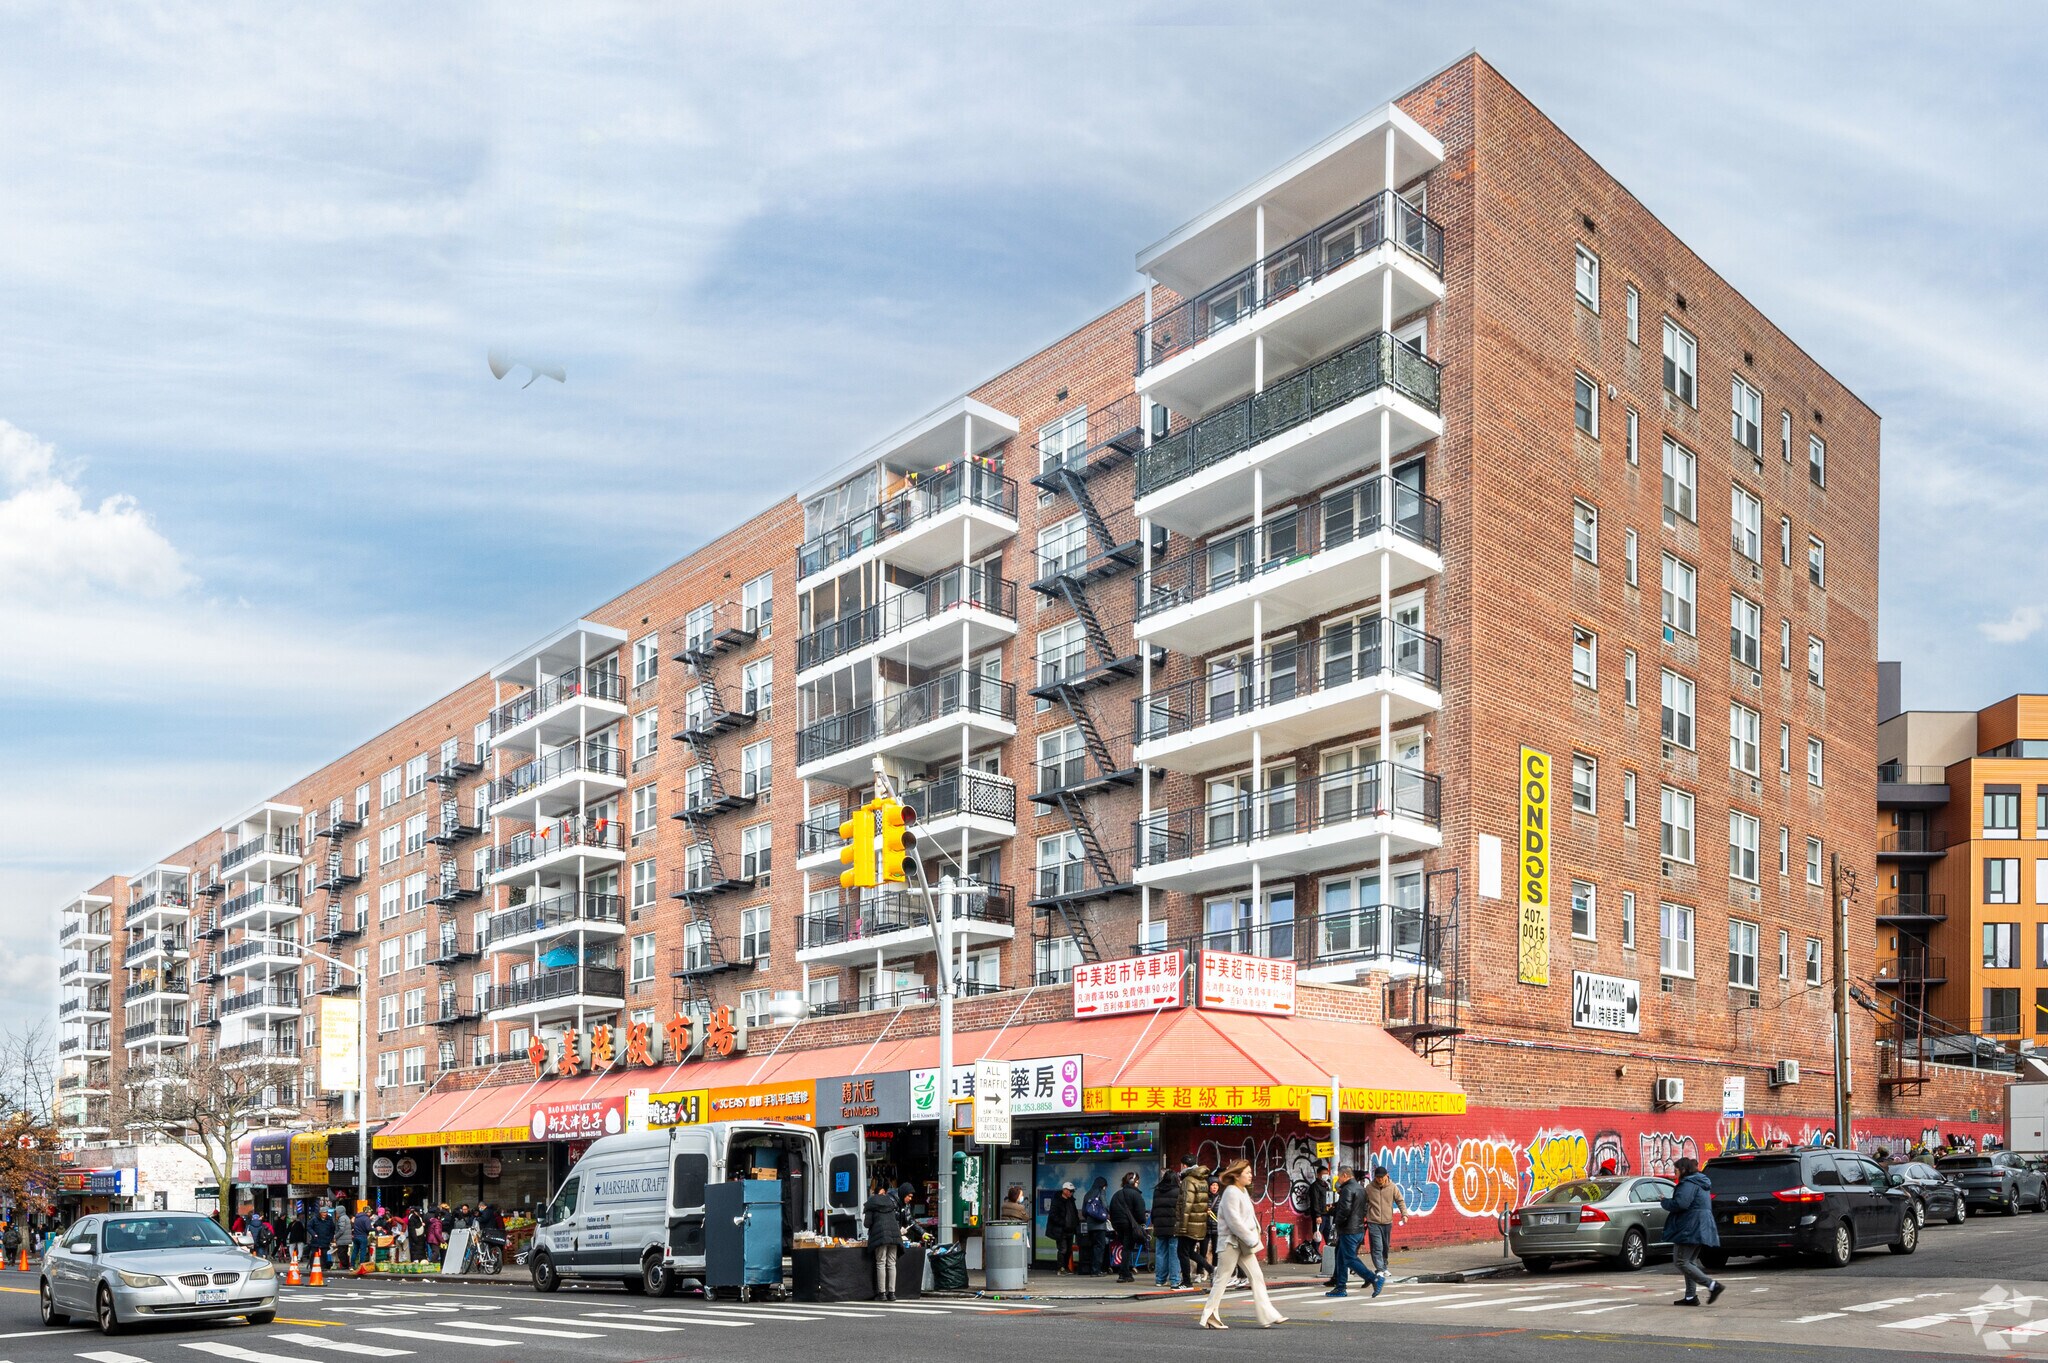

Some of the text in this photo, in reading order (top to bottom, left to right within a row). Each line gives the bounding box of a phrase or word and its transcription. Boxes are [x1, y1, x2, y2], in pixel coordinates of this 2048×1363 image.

[1526, 755, 1545, 904] CONDOS
[1076, 956, 1177, 988] 中美超市停車場
[1205, 955, 1293, 986] 中美超市停車場
[1575, 975, 1590, 1023] 24
[1592, 979, 1625, 1003] HOUR PARKING
[527, 1005, 737, 1079] 中美超級市場
[986, 1066, 1001, 1076] ALL
[979, 1078, 1008, 1090] TRAFFIC
[1121, 1086, 1271, 1108] 中美超級市場
[1368, 1092, 1445, 1112] SUPERMARKET
[1446, 1095, 1462, 1112] INC
[548, 1106, 559, 1114] BAO
[566, 1103, 590, 1112] PANCAKE
[591, 1102, 603, 1110] INC.
[840, 1107, 853, 1118] Tan
[548, 1112, 603, 1132] 新天津包子
[602, 1176, 667, 1196] MARSHARK CRAFT
